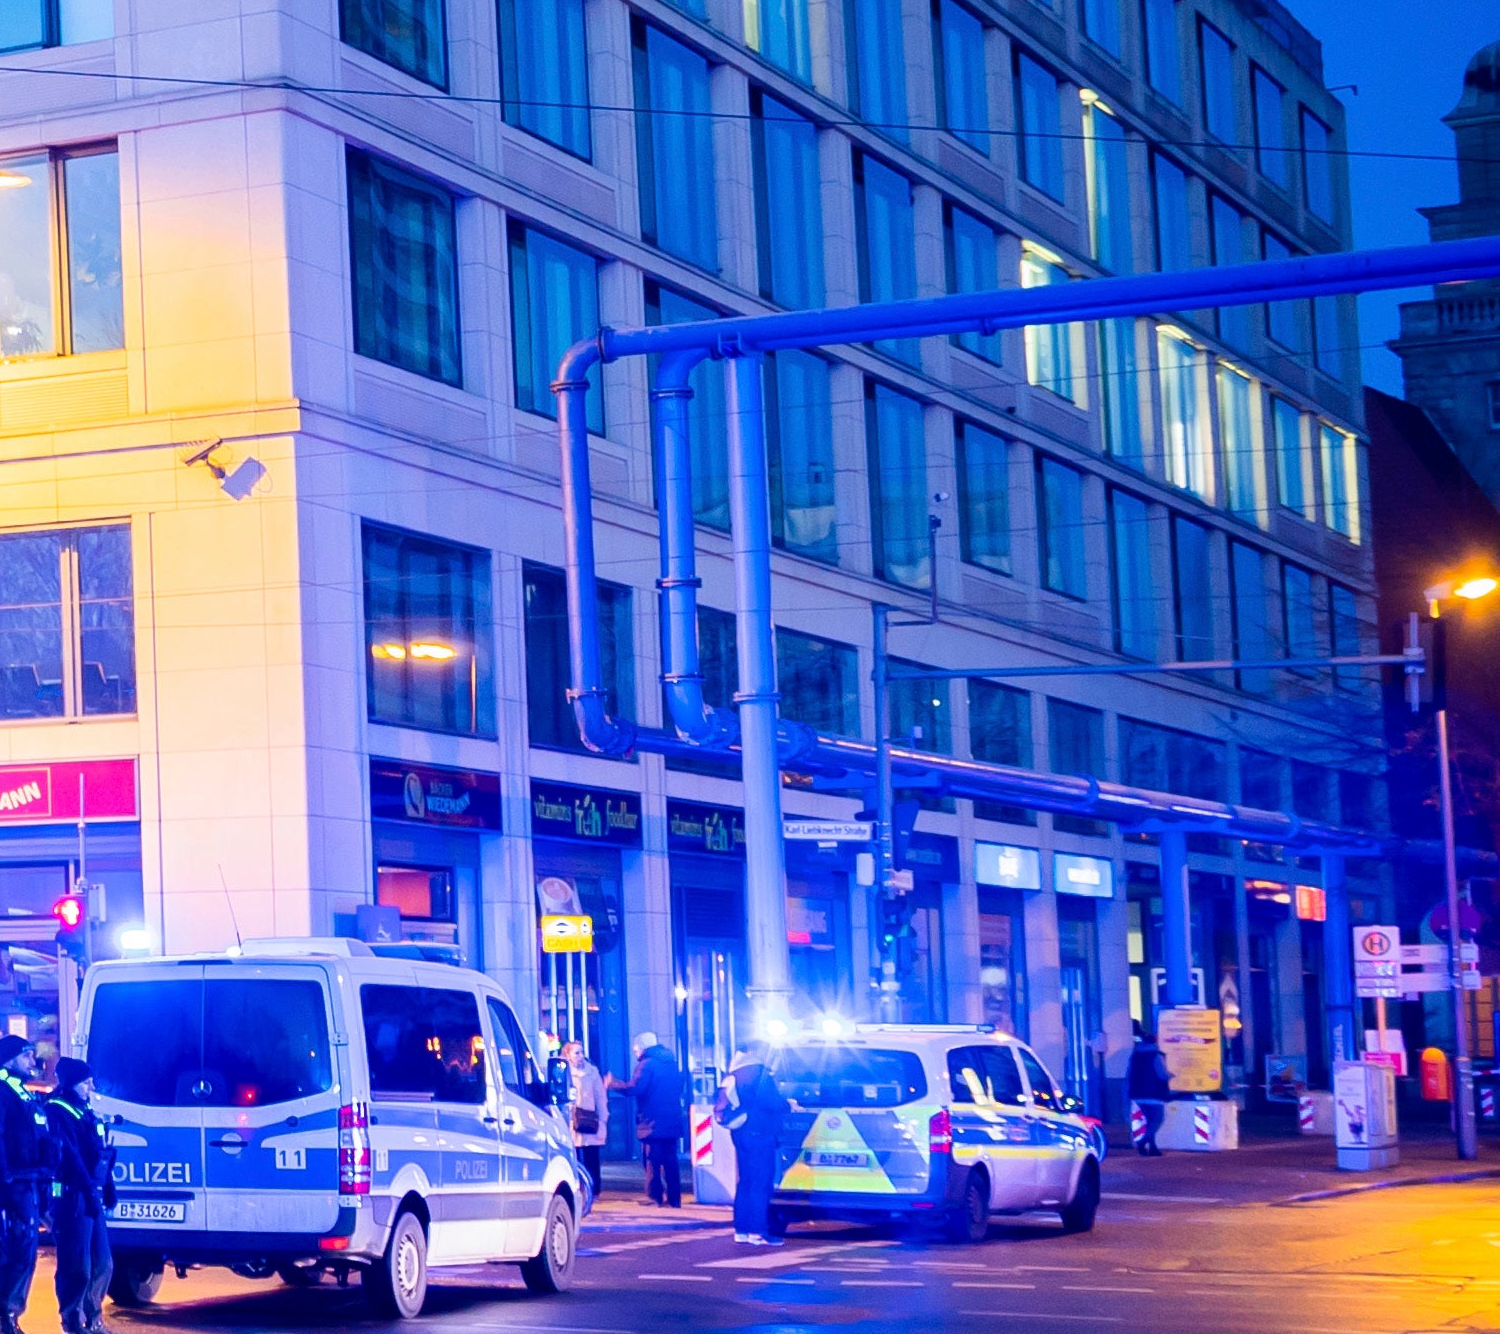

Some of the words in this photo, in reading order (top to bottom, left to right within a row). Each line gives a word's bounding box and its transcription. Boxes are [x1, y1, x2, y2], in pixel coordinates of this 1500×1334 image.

[279, 1150, 302, 1167] 11
[112, 1162, 190, 1184] OLIZEI
[455, 1160, 488, 1180] POLIZEI
[120, 1203, 128, 1217] B
[136, 1204, 177, 1219] 31626
